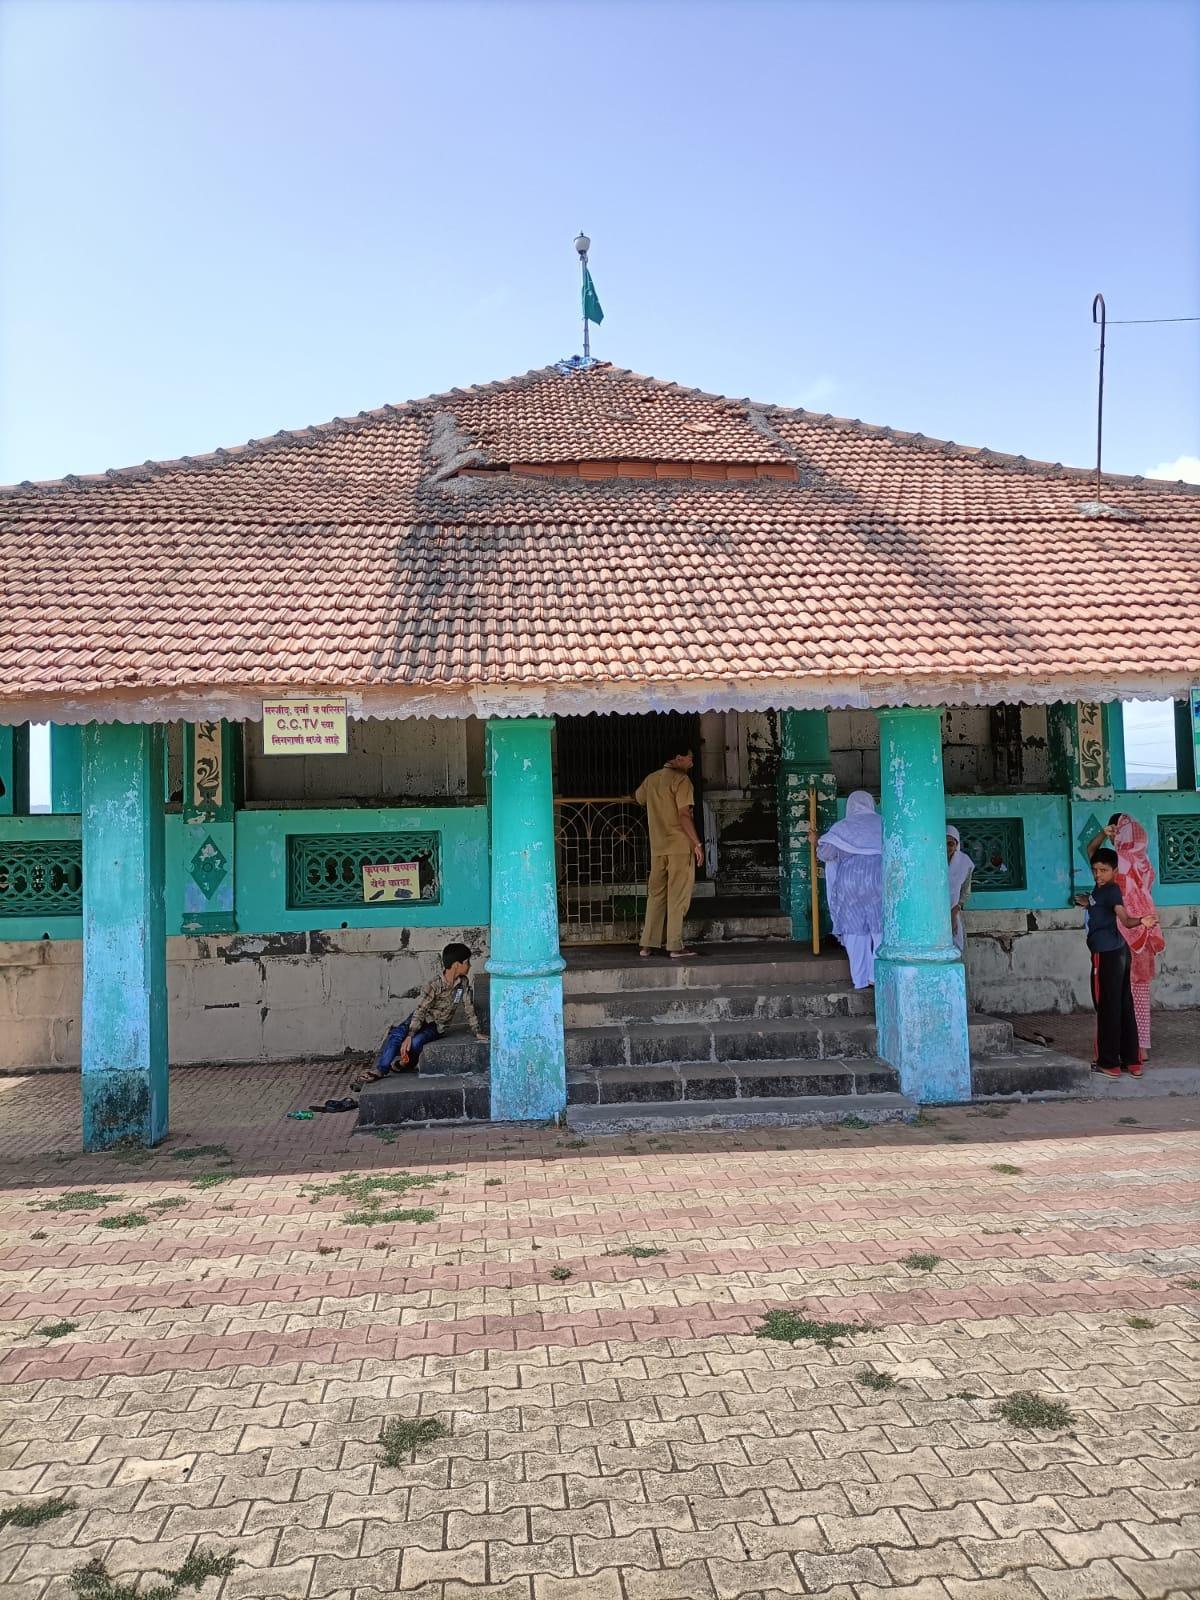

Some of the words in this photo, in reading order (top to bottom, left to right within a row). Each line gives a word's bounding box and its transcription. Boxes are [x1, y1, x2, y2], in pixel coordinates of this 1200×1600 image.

[277, 719, 318, 730] C.C.TV
[324, 734, 340, 746] आहे
[364, 866, 389, 877] कृपया
[393, 863, 417, 872] चप्पल
[370, 877, 386, 888] येथे
